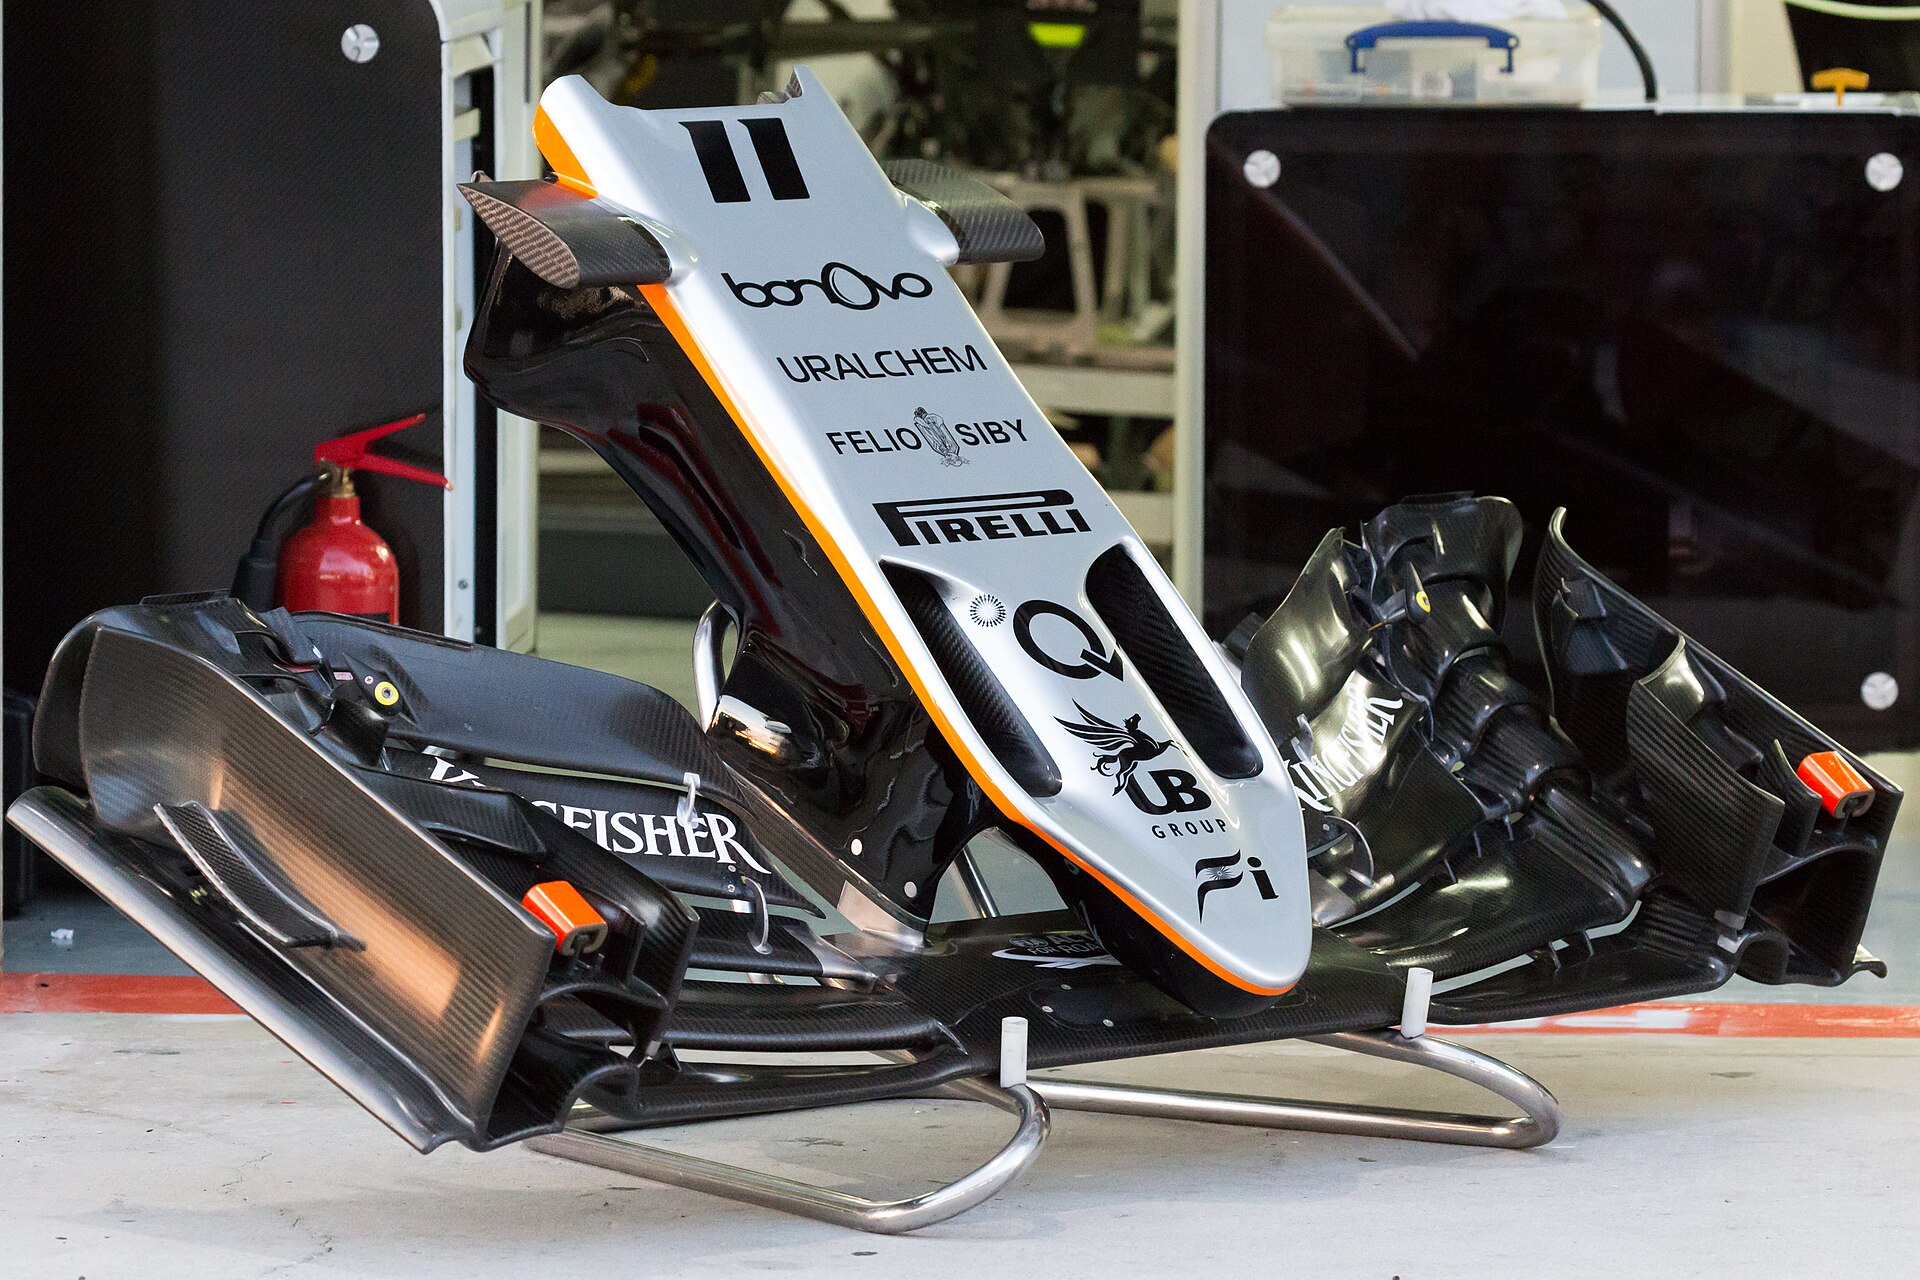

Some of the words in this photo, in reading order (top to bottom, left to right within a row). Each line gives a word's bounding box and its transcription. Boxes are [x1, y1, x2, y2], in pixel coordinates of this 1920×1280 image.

[678, 117, 810, 203] 11
[776, 344, 987, 383] URALCHEM
[826, 428, 921, 455] FELIO
[954, 418, 1028, 446] SIBY
[872, 489, 1092, 546] PIRELLI
[1151, 818, 1227, 839] GROUP
